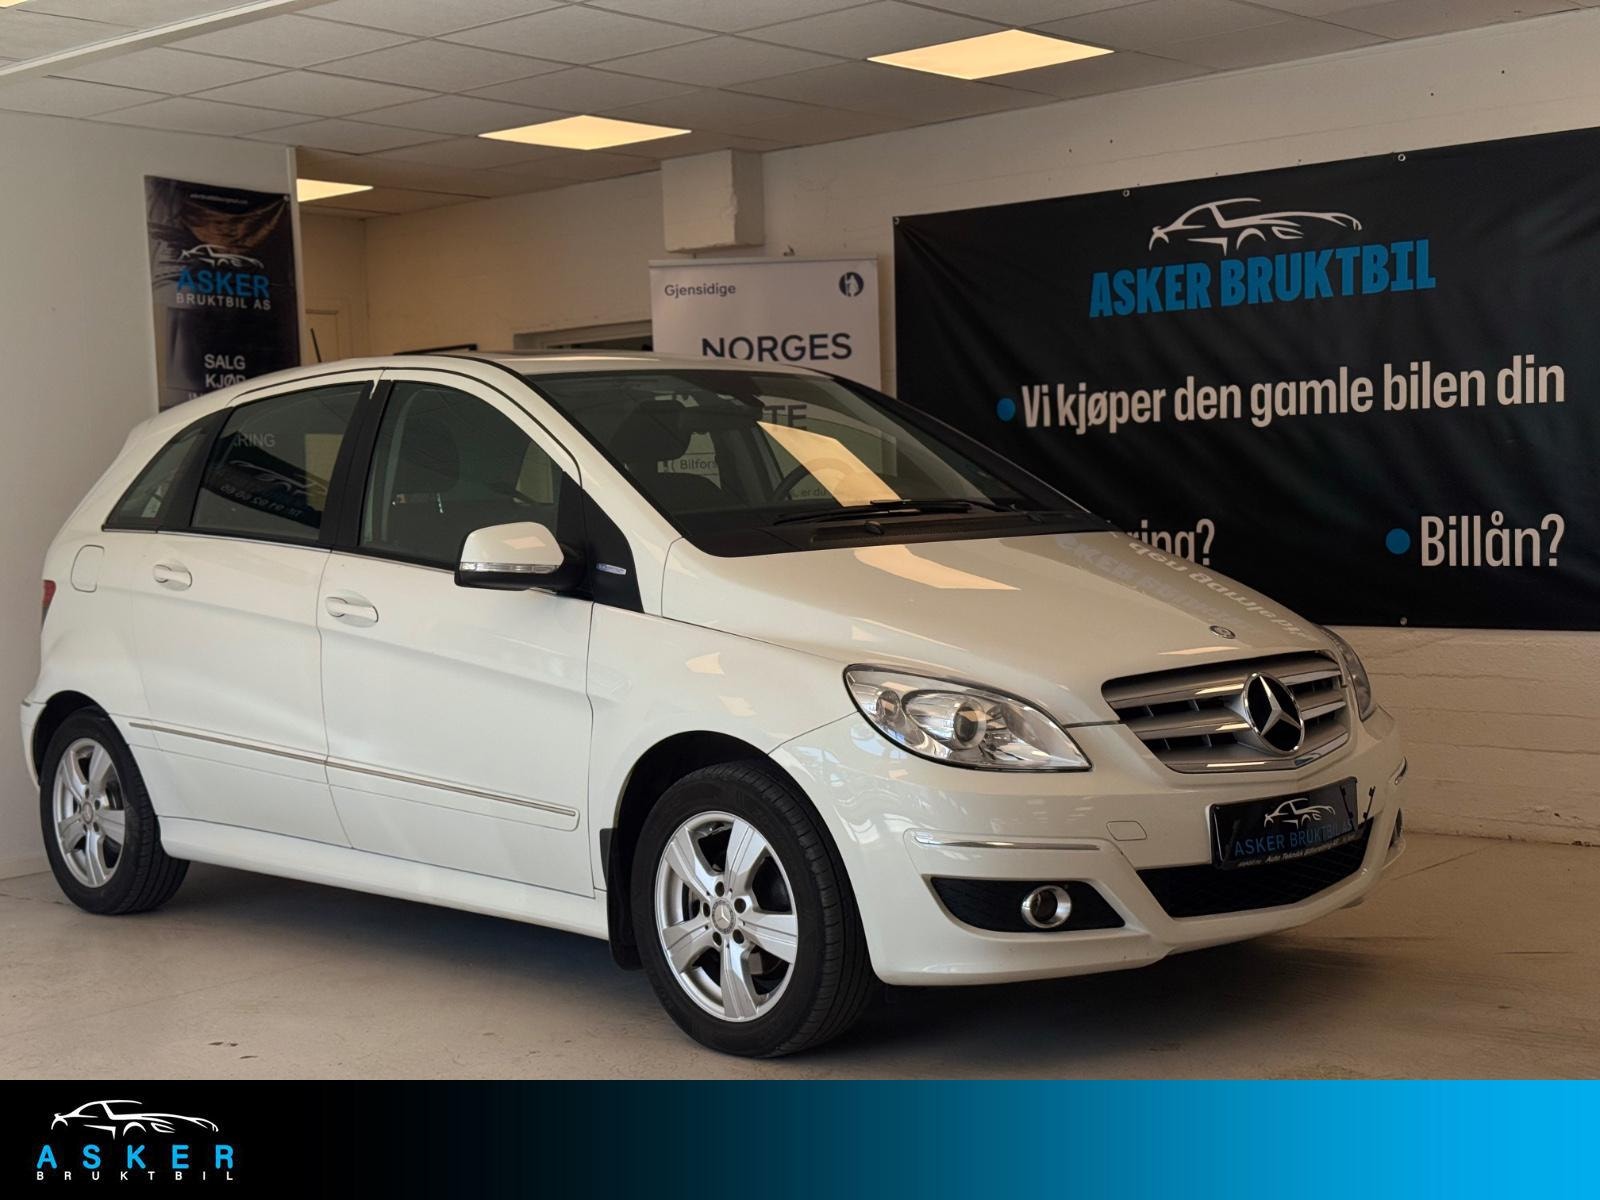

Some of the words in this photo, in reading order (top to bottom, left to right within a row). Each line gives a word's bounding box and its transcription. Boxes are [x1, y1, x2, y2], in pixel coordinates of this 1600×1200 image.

[176, 266, 270, 298] ASKER
[664, 282, 737, 299] Gjensidige
[1089, 262, 1211, 318] ASKER
[1220, 239, 1437, 307] BRUKTBIL
[176, 293, 248, 308] BRUKTBIL
[253, 299, 271, 311] AS
[204, 353, 246, 370] SALG
[702, 333, 852, 362] NORGES
[1021, 383, 1051, 428] Vi
[1057, 382, 1167, 435] kjøper
[1173, 376, 1242, 421] den
[1250, 366, 1374, 428] gamle
[1383, 360, 1485, 411] bilen
[1496, 354, 1566, 405] din
[1420, 510, 1566, 567] Billån?
[1234, 833, 1286, 857] ASKER
